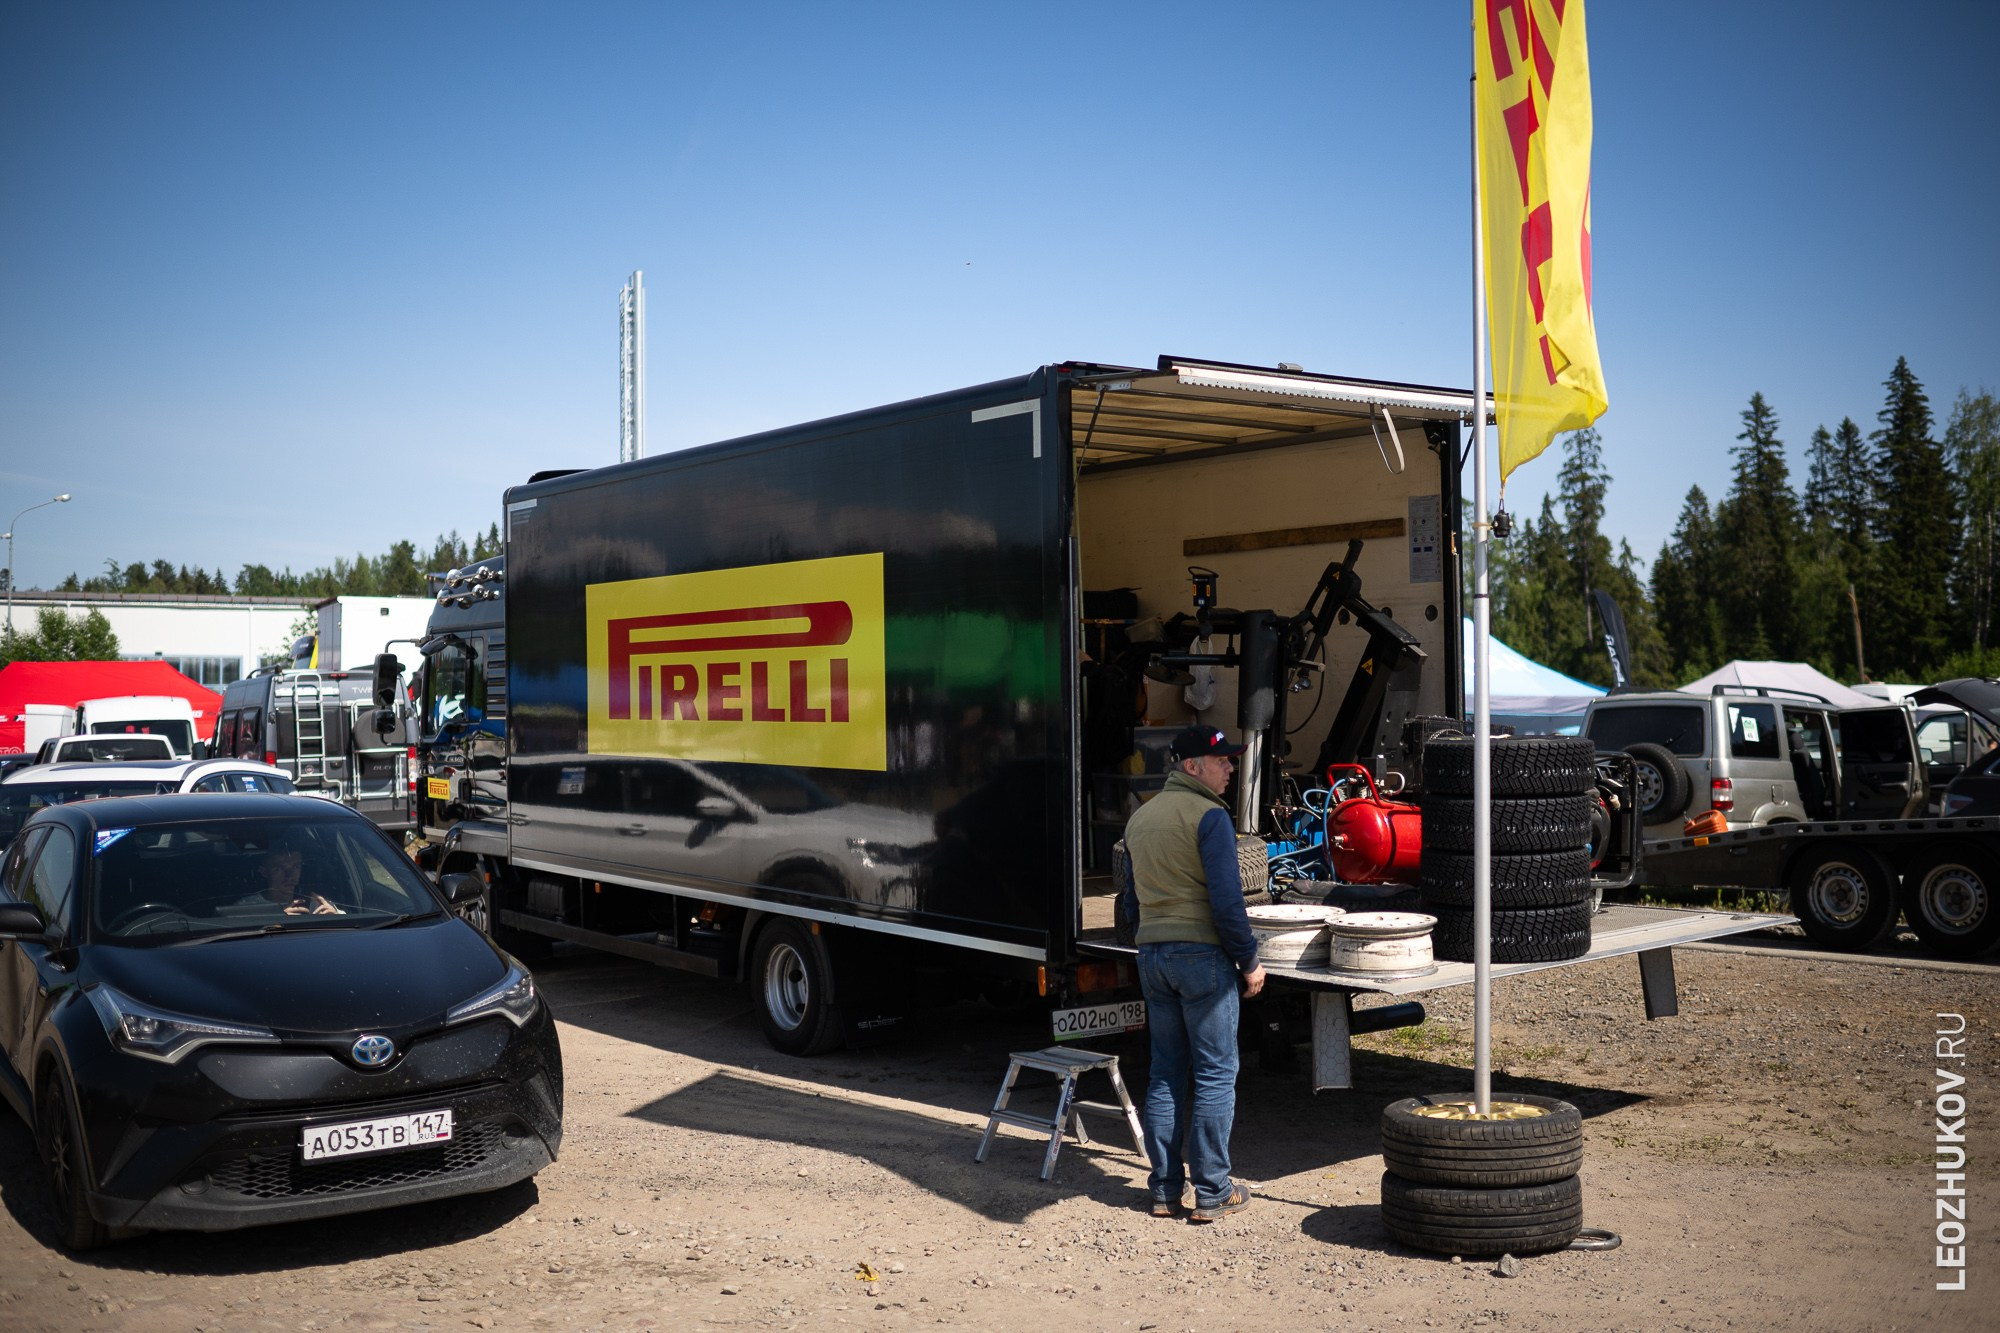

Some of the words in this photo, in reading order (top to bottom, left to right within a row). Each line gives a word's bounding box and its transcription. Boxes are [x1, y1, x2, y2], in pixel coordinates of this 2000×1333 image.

[607, 600, 853, 722] PIRELLI
[429, 781, 448, 796] PIRELLI
[1120, 1003, 1141, 1019] 198
[411, 1113, 445, 1134] 147
[418, 1131, 436, 1140] RUS
